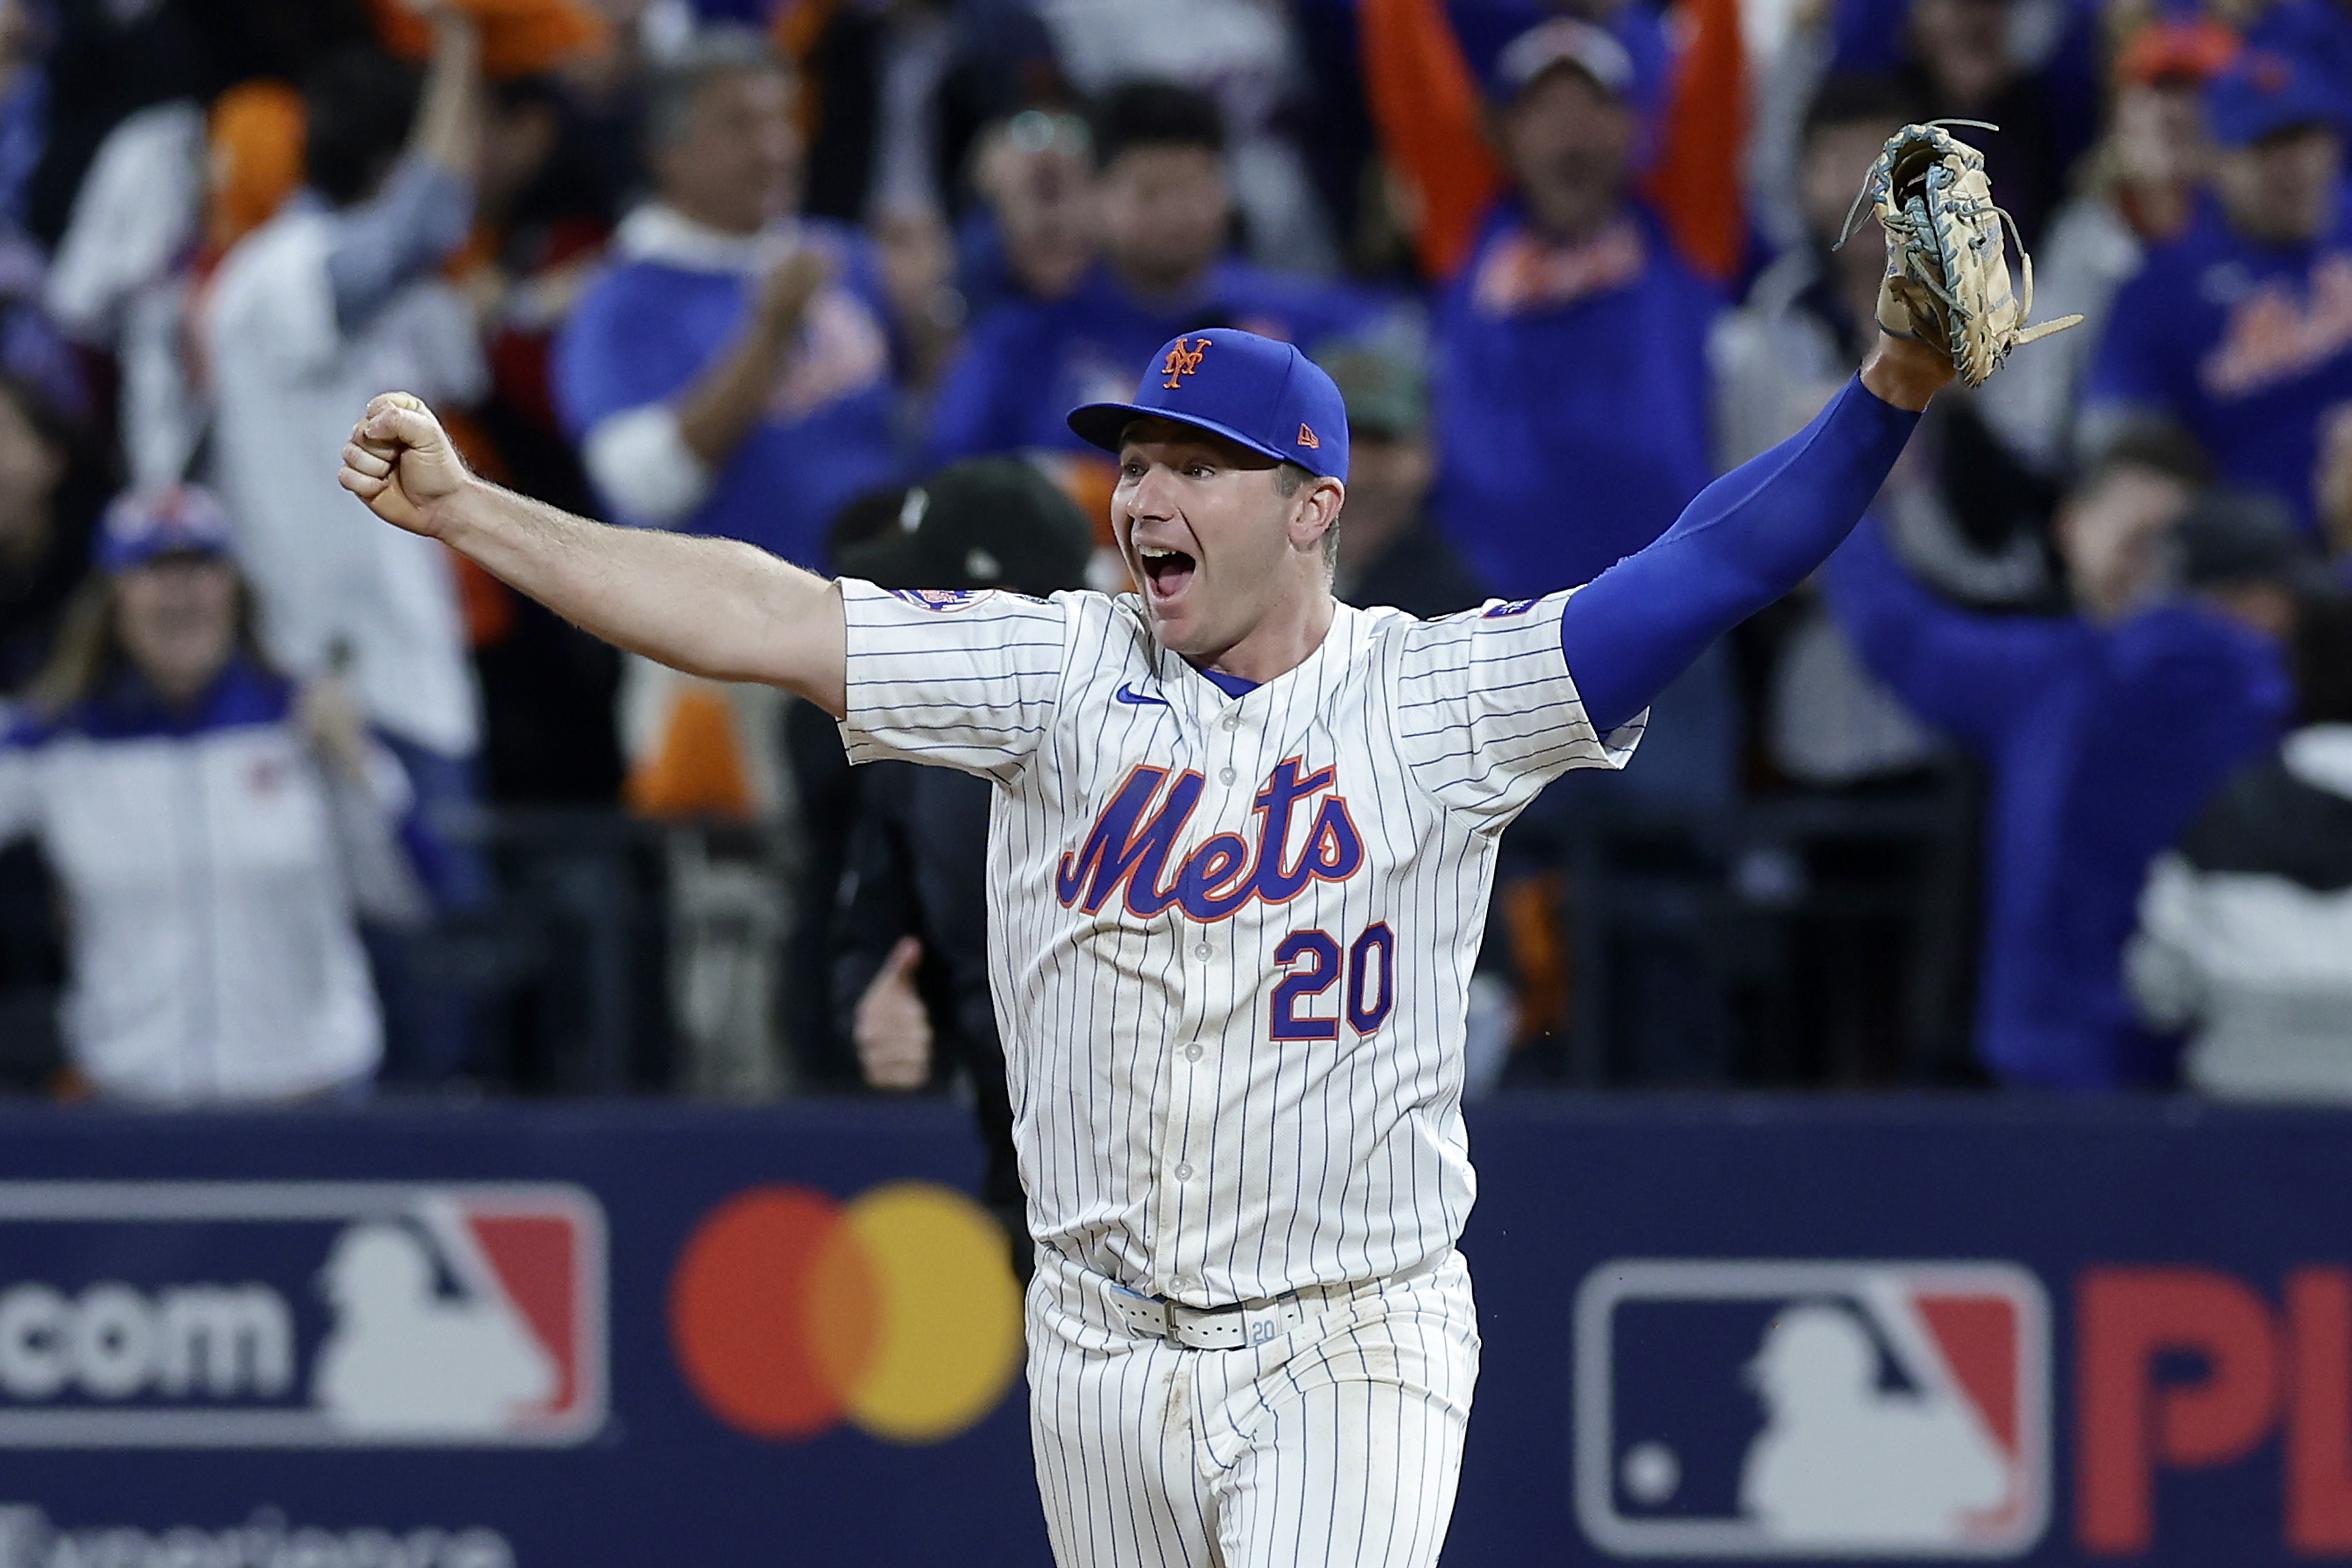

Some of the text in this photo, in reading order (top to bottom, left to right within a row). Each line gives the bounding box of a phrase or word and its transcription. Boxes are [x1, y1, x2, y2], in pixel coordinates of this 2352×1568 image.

[1055, 755, 1365, 925] Mets
[1269, 921, 1395, 1042] 20
[1252, 1319, 1275, 1345] 20
